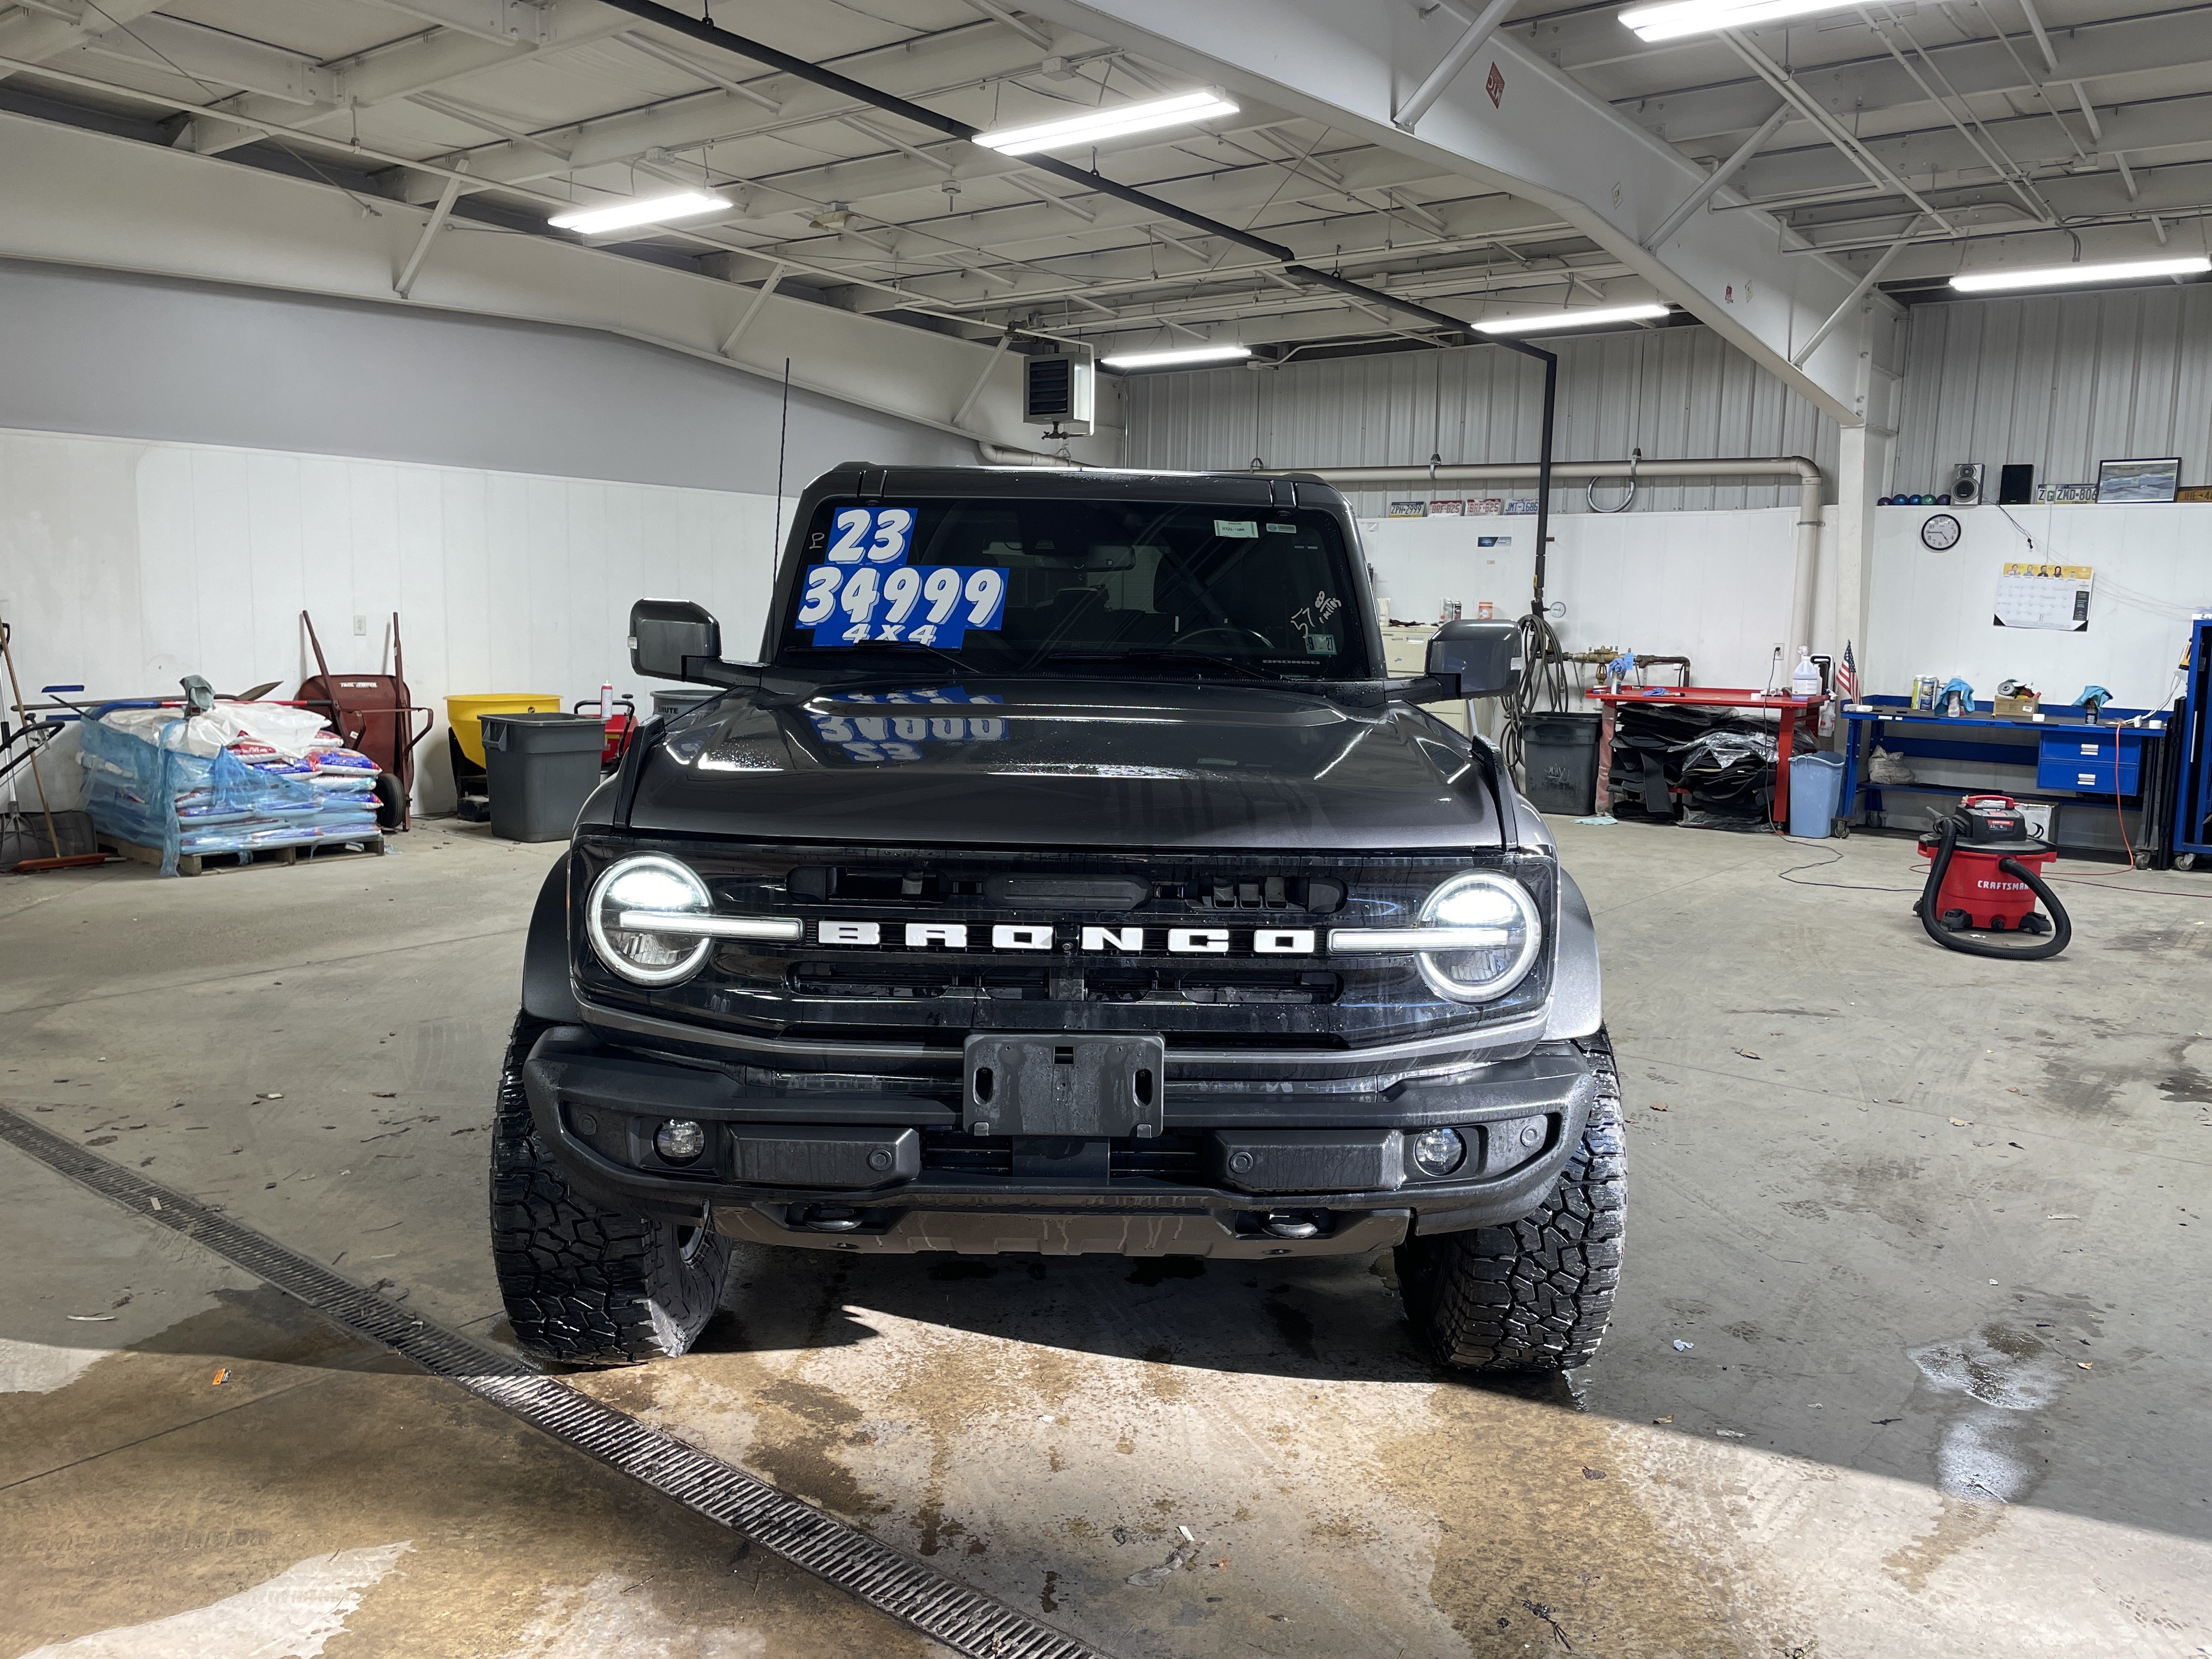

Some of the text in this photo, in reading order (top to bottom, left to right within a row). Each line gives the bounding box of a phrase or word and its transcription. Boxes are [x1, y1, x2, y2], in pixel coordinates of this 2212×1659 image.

[1505, 501, 1539, 512] JMT-1686
[828, 509, 912, 565] 23
[798, 566, 1005, 627] 34999
[818, 921, 1316, 954] BRONCO
